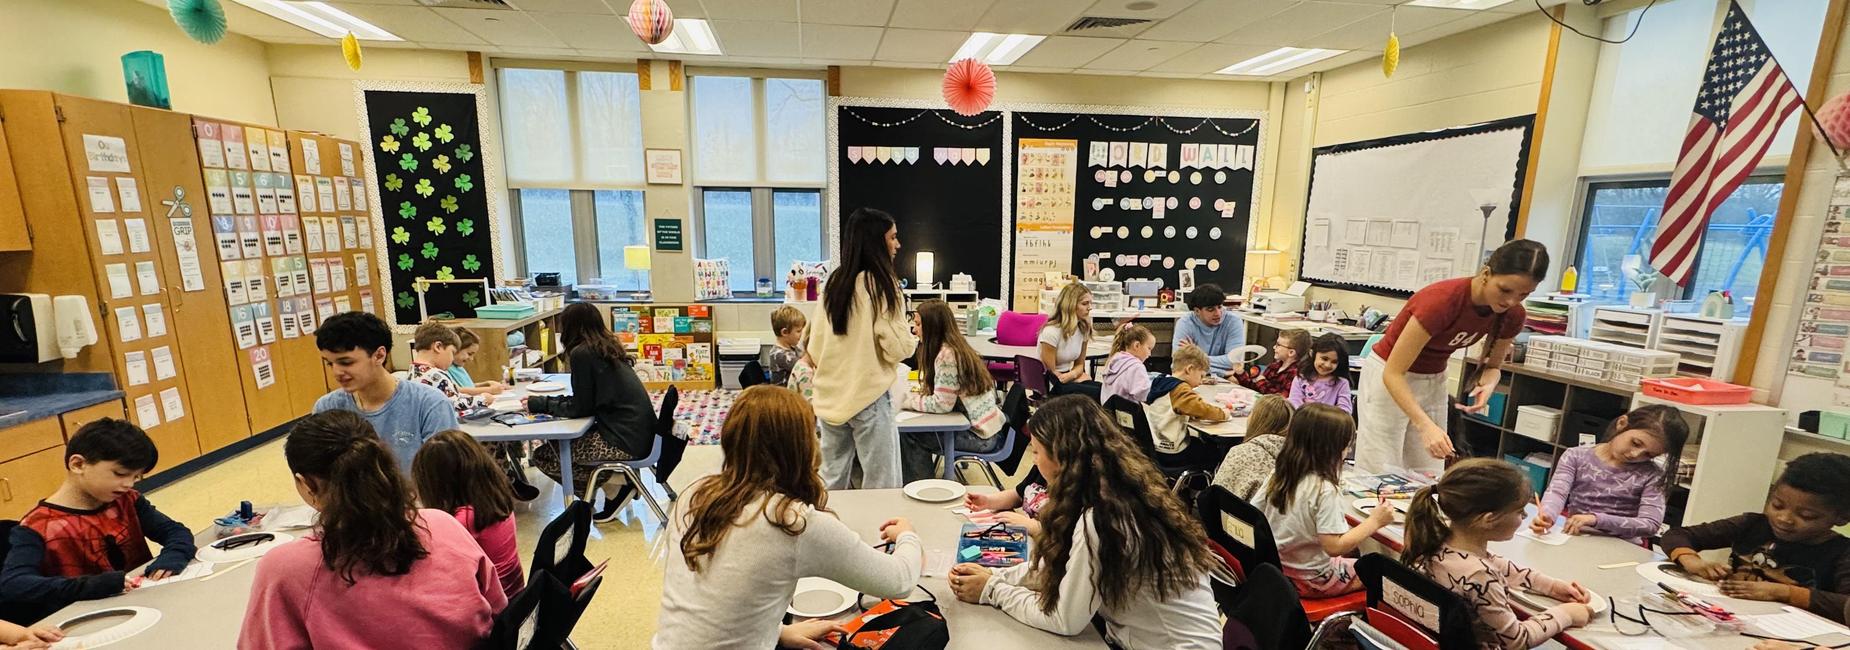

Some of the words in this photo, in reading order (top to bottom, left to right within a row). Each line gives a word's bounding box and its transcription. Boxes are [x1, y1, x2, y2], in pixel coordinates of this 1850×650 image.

[204, 123, 213, 137] 0
[1092, 143, 1162, 163] WORD
[1183, 145, 1246, 164] WALL
[236, 173, 243, 185] 5
[260, 174, 267, 186] 6
[279, 175, 285, 187] 7
[264, 216, 276, 230] 10
[174, 226, 191, 236] GRIP
[282, 300, 291, 312] 18
[254, 347, 266, 361] 20
